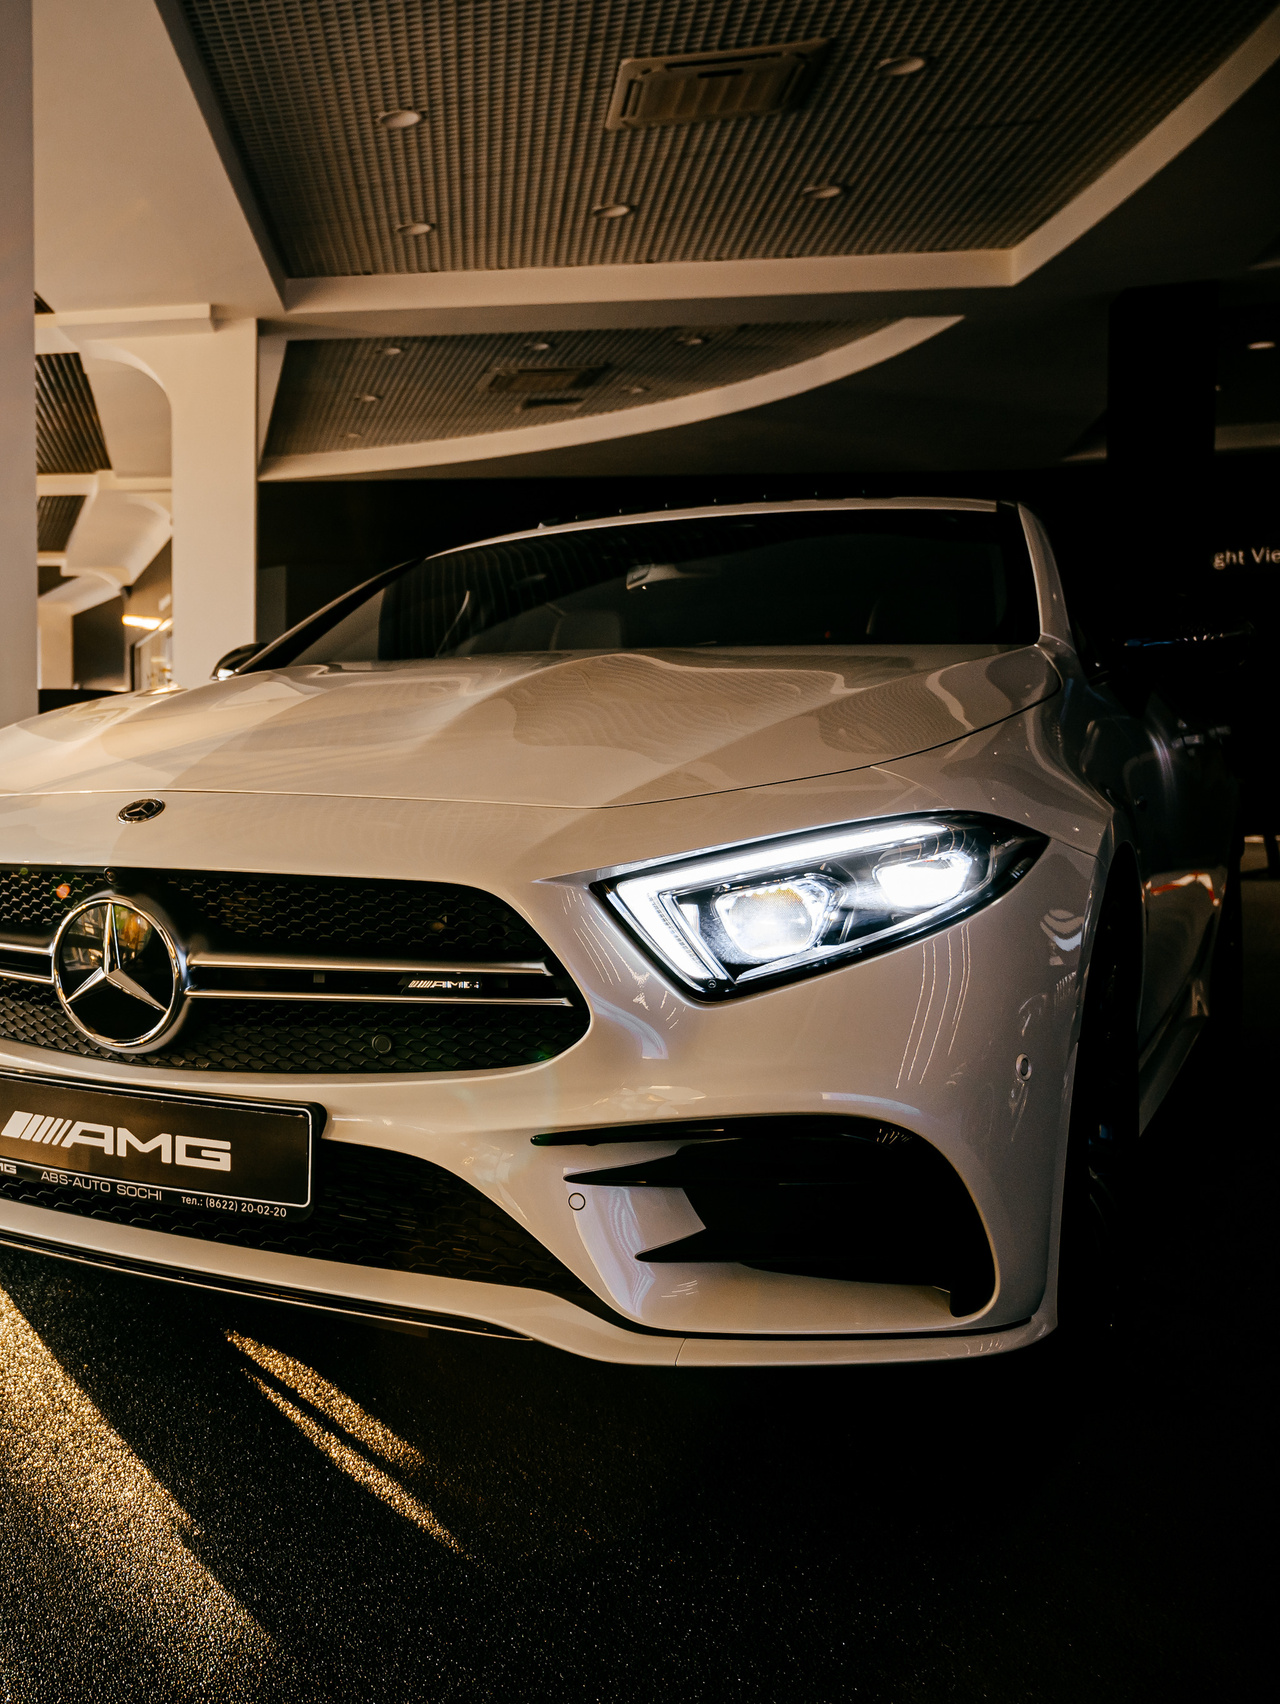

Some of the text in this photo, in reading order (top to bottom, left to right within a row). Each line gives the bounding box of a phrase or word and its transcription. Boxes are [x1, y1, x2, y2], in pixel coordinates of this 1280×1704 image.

[60, 1120, 232, 1172] AMG
[40, 1170, 162, 1201] ABS-AUTO SOCHI
[181, 1195, 287, 1218] тел.: (8622) 20-02-20
